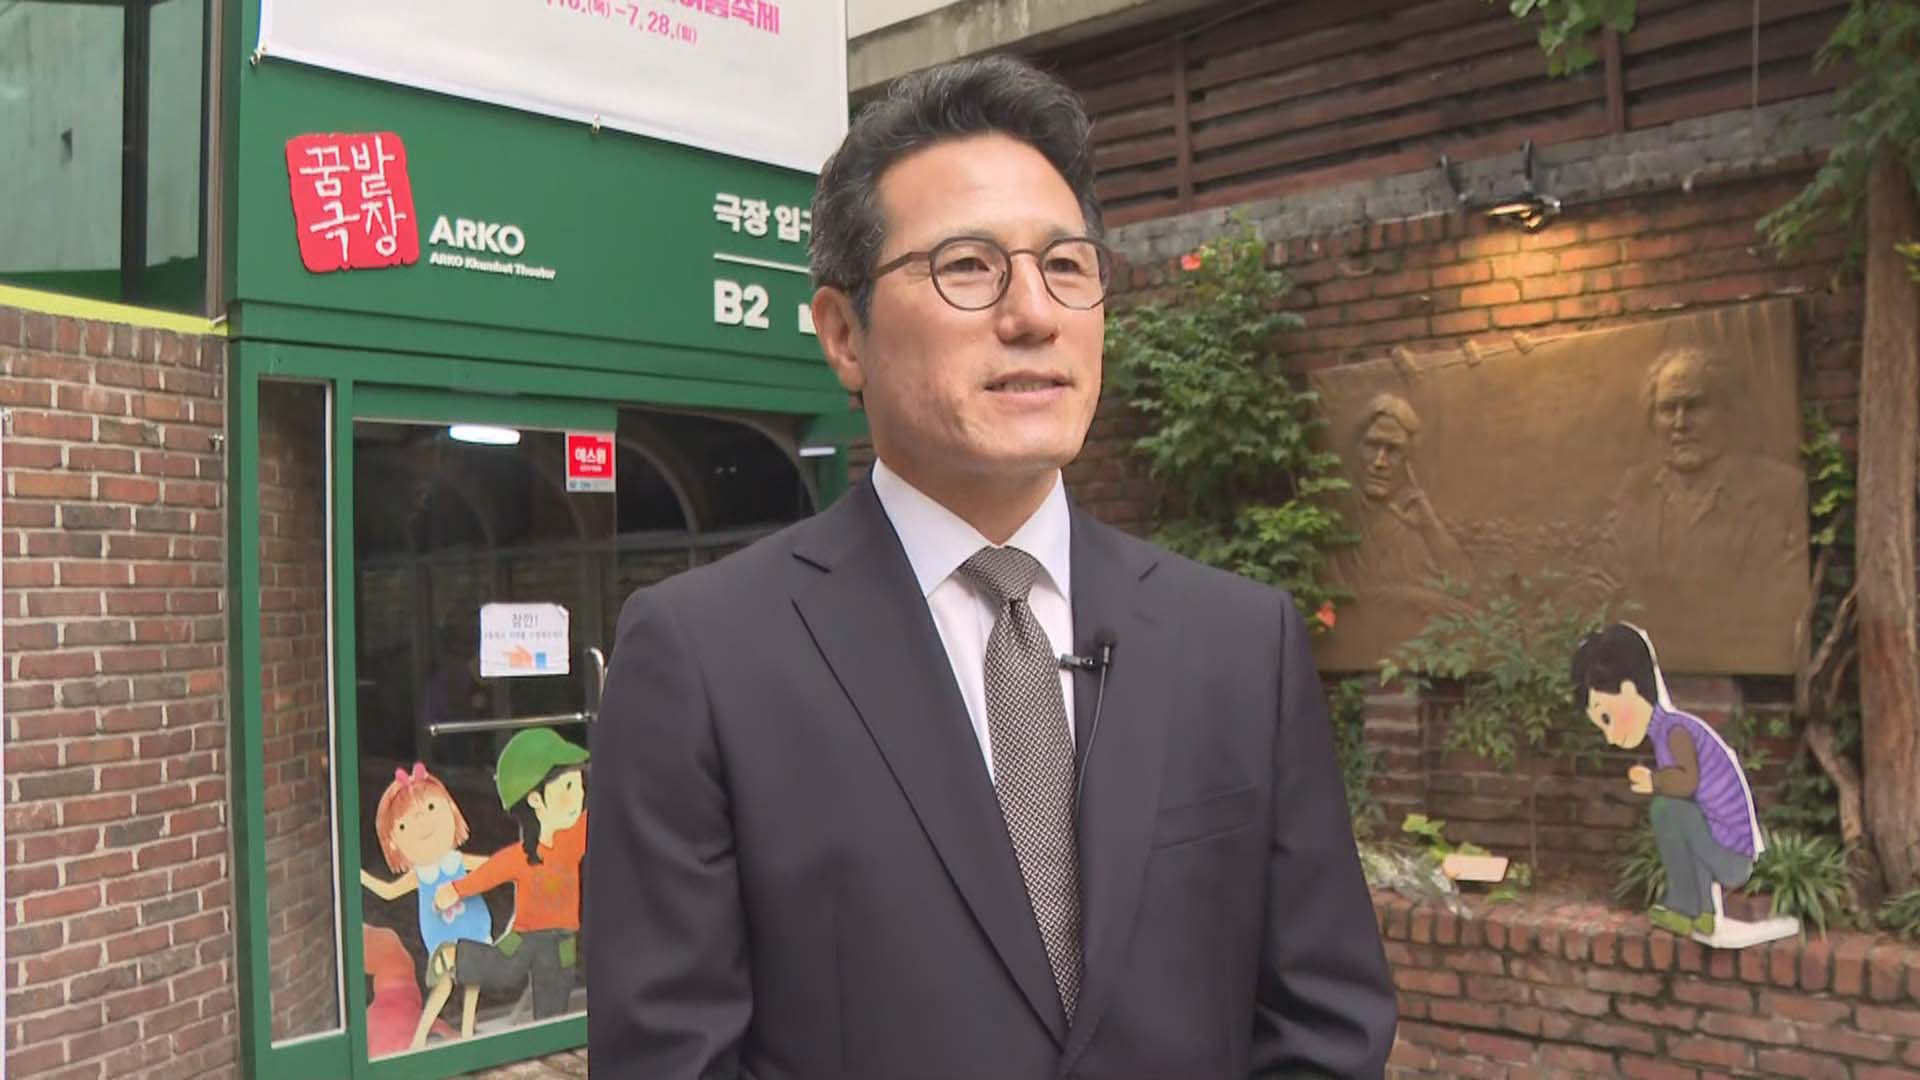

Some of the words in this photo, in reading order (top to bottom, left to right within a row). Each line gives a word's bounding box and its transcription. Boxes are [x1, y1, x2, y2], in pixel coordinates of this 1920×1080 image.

[298, 135, 396, 199] 꿈밭
[309, 195, 407, 262] 극장
[428, 214, 526, 256] ARKO
[713, 191, 771, 237] 극장
[429, 252, 464, 268] ARKO
[514, 263, 557, 281] Theater
[713, 279, 770, 329] B2
